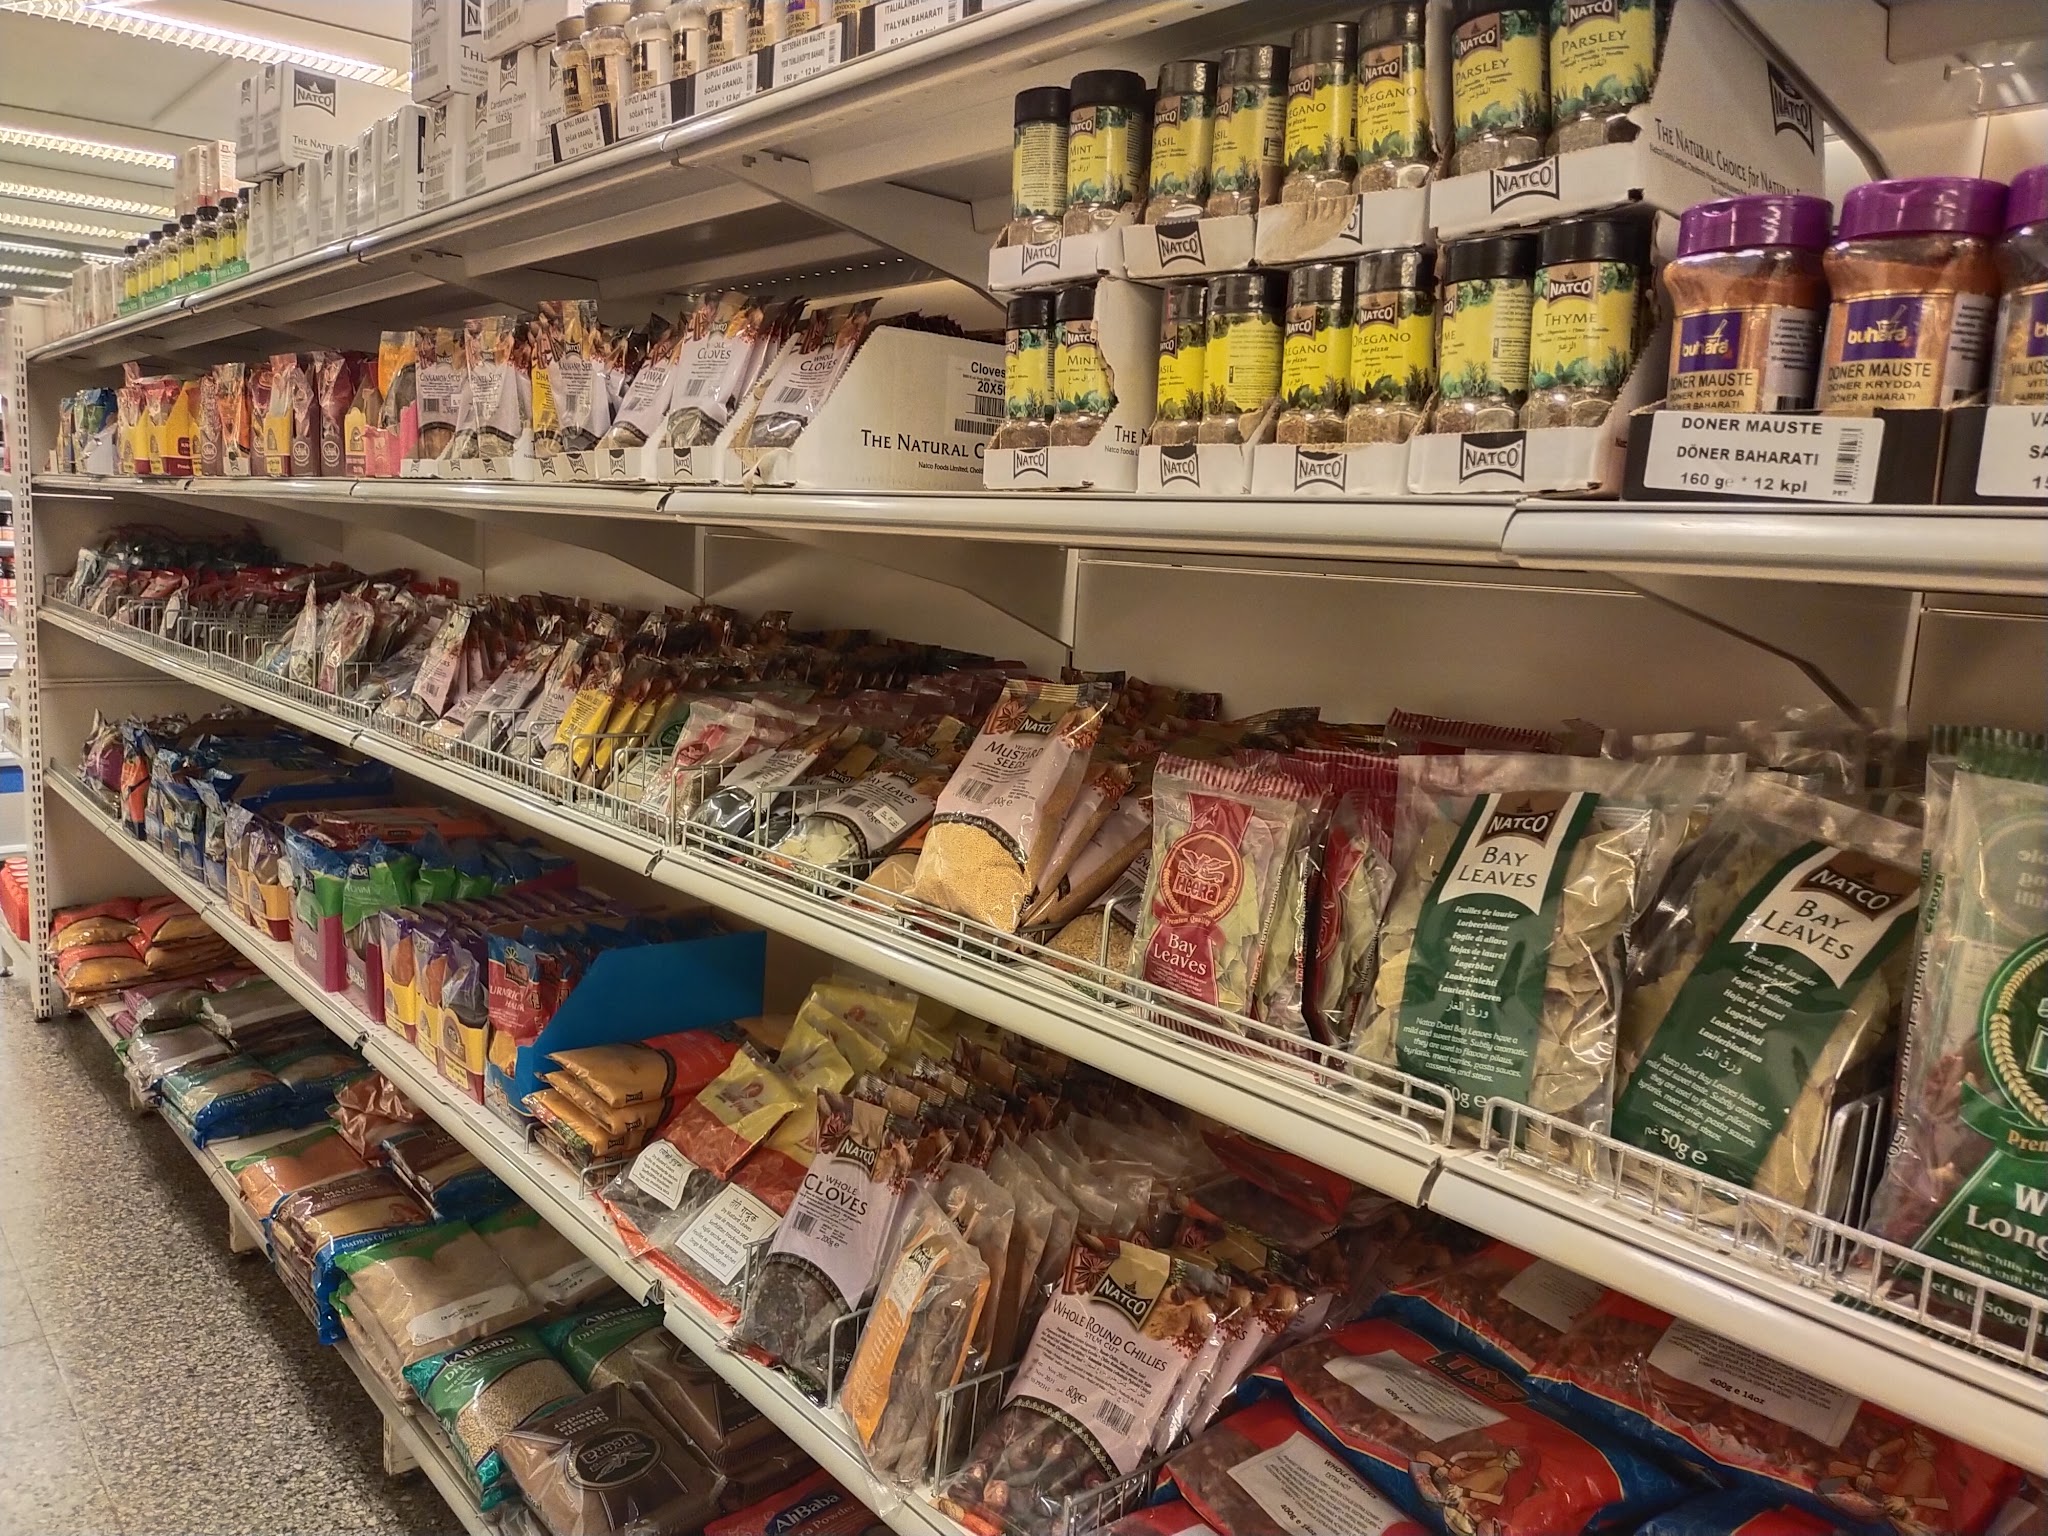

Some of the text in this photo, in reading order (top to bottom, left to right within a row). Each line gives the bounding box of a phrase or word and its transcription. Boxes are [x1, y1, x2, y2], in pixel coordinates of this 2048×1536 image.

[1570, 0, 1613, 23] NATCO
[1460, 31, 1496, 55] NATCO
[1561, 30, 1627, 56] PARSLEY
[1366, 62, 1398, 82] NATCO
[1456, 58, 1510, 86] PARSLEY
[296, 85, 332, 107] NATCO
[1774, 97, 1811, 132] NATCO
[292, 135, 308, 147] THE
[1655, 118, 1674, 146] THE
[1675, 127, 1715, 167] NATURAL
[1716, 150, 1746, 182] CHOICE
[1495, 166, 1554, 193] NATCO
[1025, 243, 1058, 261] NATCO
[1161, 238, 1199, 256] NATCO
[1550, 282, 1593, 299] NATCO
[1361, 307, 1393, 324] NATCO
[1544, 312, 1598, 328] THYME
[1353, 332, 1412, 349] OREGANO
[1848, 326, 1908, 346] buhara
[1682, 341, 1729, 358] buhara
[800, 358, 838, 374] CLOVES
[971, 361, 1006, 379] Cloves
[1067, 355, 1099, 367] MINT
[1859, 361, 1932, 379] MAUSTE
[1698, 371, 1754, 389] MAUSTE
[1860, 379, 1922, 390] KRYDDA
[1696, 388, 1745, 399] KRYDDA
[1860, 391, 1916, 402] BAHARATI
[1115, 425, 1137, 444] THE
[1682, 417, 1823, 435] DONER MAUSTE
[861, 429, 969, 458] THE NATURAL
[1105, 446, 1135, 456] Natco Foods
[1016, 453, 1046, 467] NATCO
[1464, 446, 1520, 469] NATCO
[1676, 444, 1819, 466] DÖNER BAHARATI
[918, 461, 934, 470] Natco
[1163, 462, 1196, 476] NATCO
[1299, 460, 1342, 479] NATCO
[1680, 472, 1807, 494] 160 12 kpl
[984, 741, 1043, 761] MUSTARD
[994, 756, 1027, 770] SEEDS
[881, 782, 918, 805] LEAVES
[1487, 814, 1550, 834] NATCO
[1482, 846, 1529, 868] BAY
[1457, 865, 1539, 889] LEAVES
[1810, 868, 1891, 911] NATCO
[1455, 905, 1520, 919] Feuilles de laurier
[1795, 898, 1850, 931] BAY
[1168, 932, 1197, 958] Bay
[1452, 931, 1508, 946] Foglie di alloro
[1761, 909, 1855, 962] LEAVES
[1153, 943, 1207, 976] Leaves
[1449, 944, 1508, 961] Hojas de laurel
[1454, 959, 1495, 973] Lagerblad
[1437, 983, 1502, 1003] Laurierbladeren
[1722, 988, 1786, 1022] Hojas de laurel
[840, 1139, 876, 1166] NATCO
[1660, 1127, 1691, 1160] 50g
[804, 1173, 869, 1216] CLOVES
[825, 1174, 858, 1196] WHOLE
[1099, 1279, 1147, 1316] NATCO
[1053, 1299, 1168, 1372] WHOLE ROUND CHILLIES
[1084, 1331, 1121, 1354] STEM CUT
[451, 1335, 515, 1366] AliBaba
[1709, 1376, 1766, 1406] 400g 14oz
[1324, 1458, 1349, 1478] WHOLE
[775, 1493, 840, 1534] AliBaba
[1280, 1503, 1297, 1521] 400g
